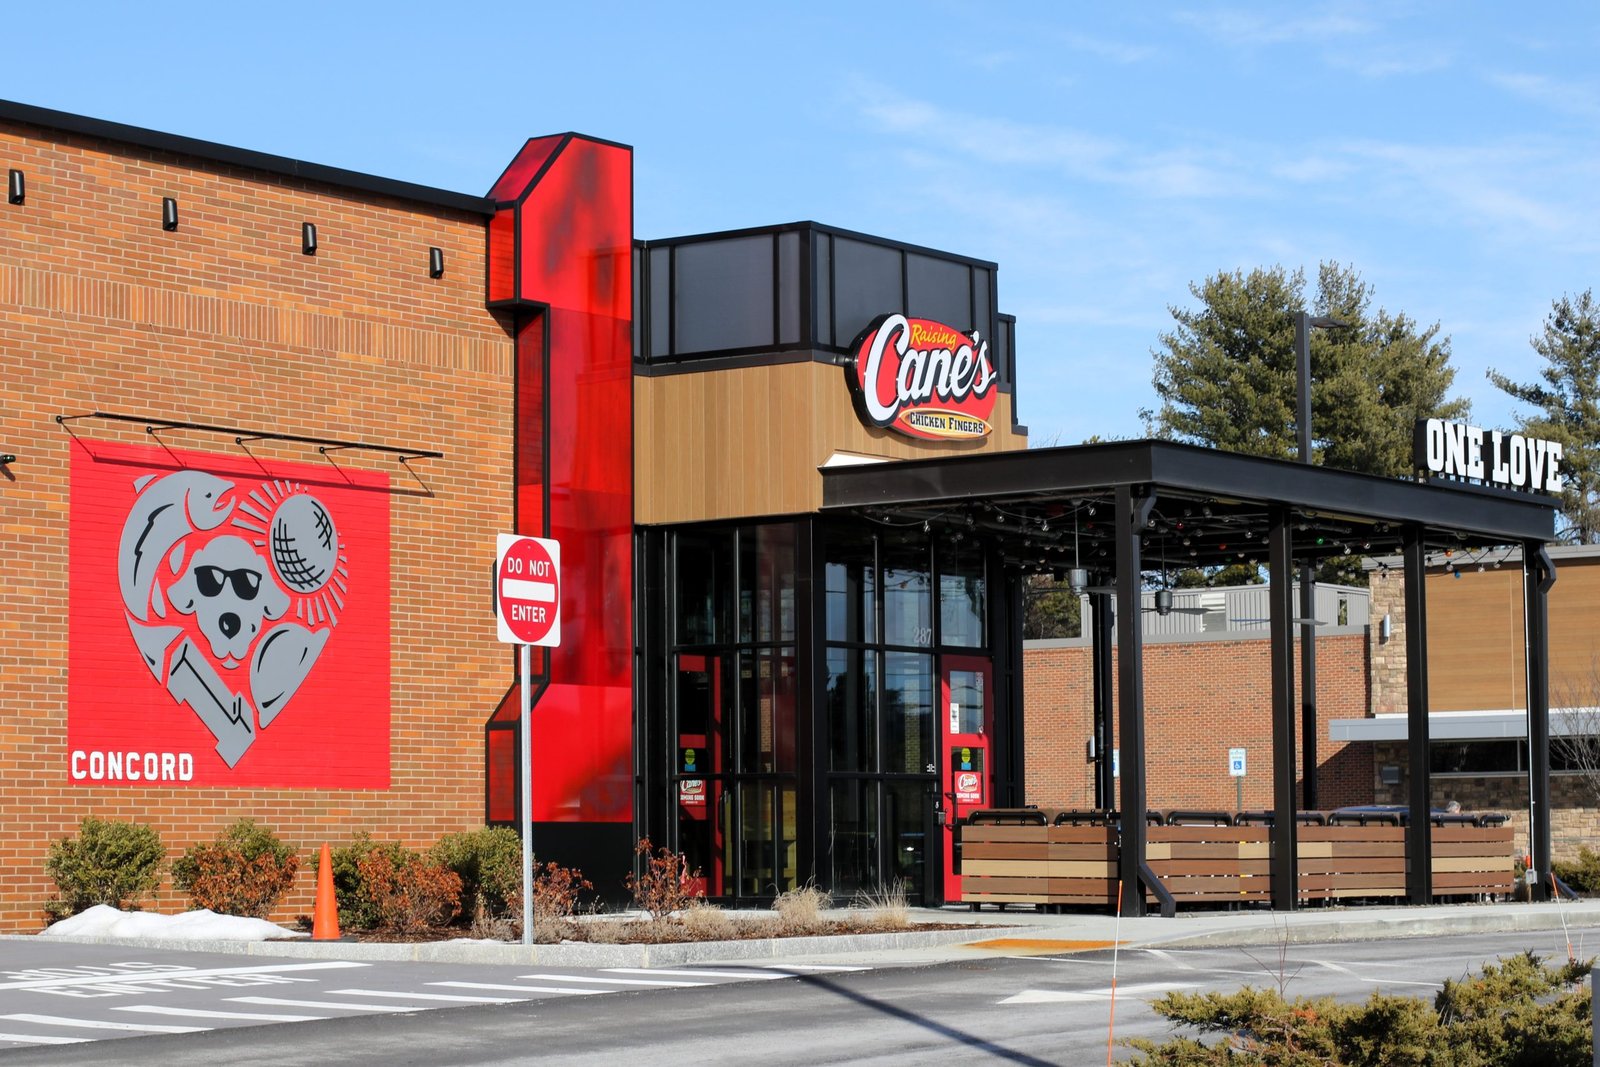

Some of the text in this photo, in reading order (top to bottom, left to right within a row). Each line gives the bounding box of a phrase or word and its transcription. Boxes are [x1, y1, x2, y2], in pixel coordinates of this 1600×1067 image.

[910, 324, 957, 350] Raising
[864, 313, 997, 421] Cane's
[910, 412, 983, 434] CHICKEN FINGERS
[1426, 418, 1562, 492] ONE LOVE
[507, 557, 550, 578] DO NOT
[512, 604, 546, 623] ENTER
[913, 626, 931, 645] 287
[71, 750, 193, 781] CONCORD
[19, 973, 320, 998] ENTER
